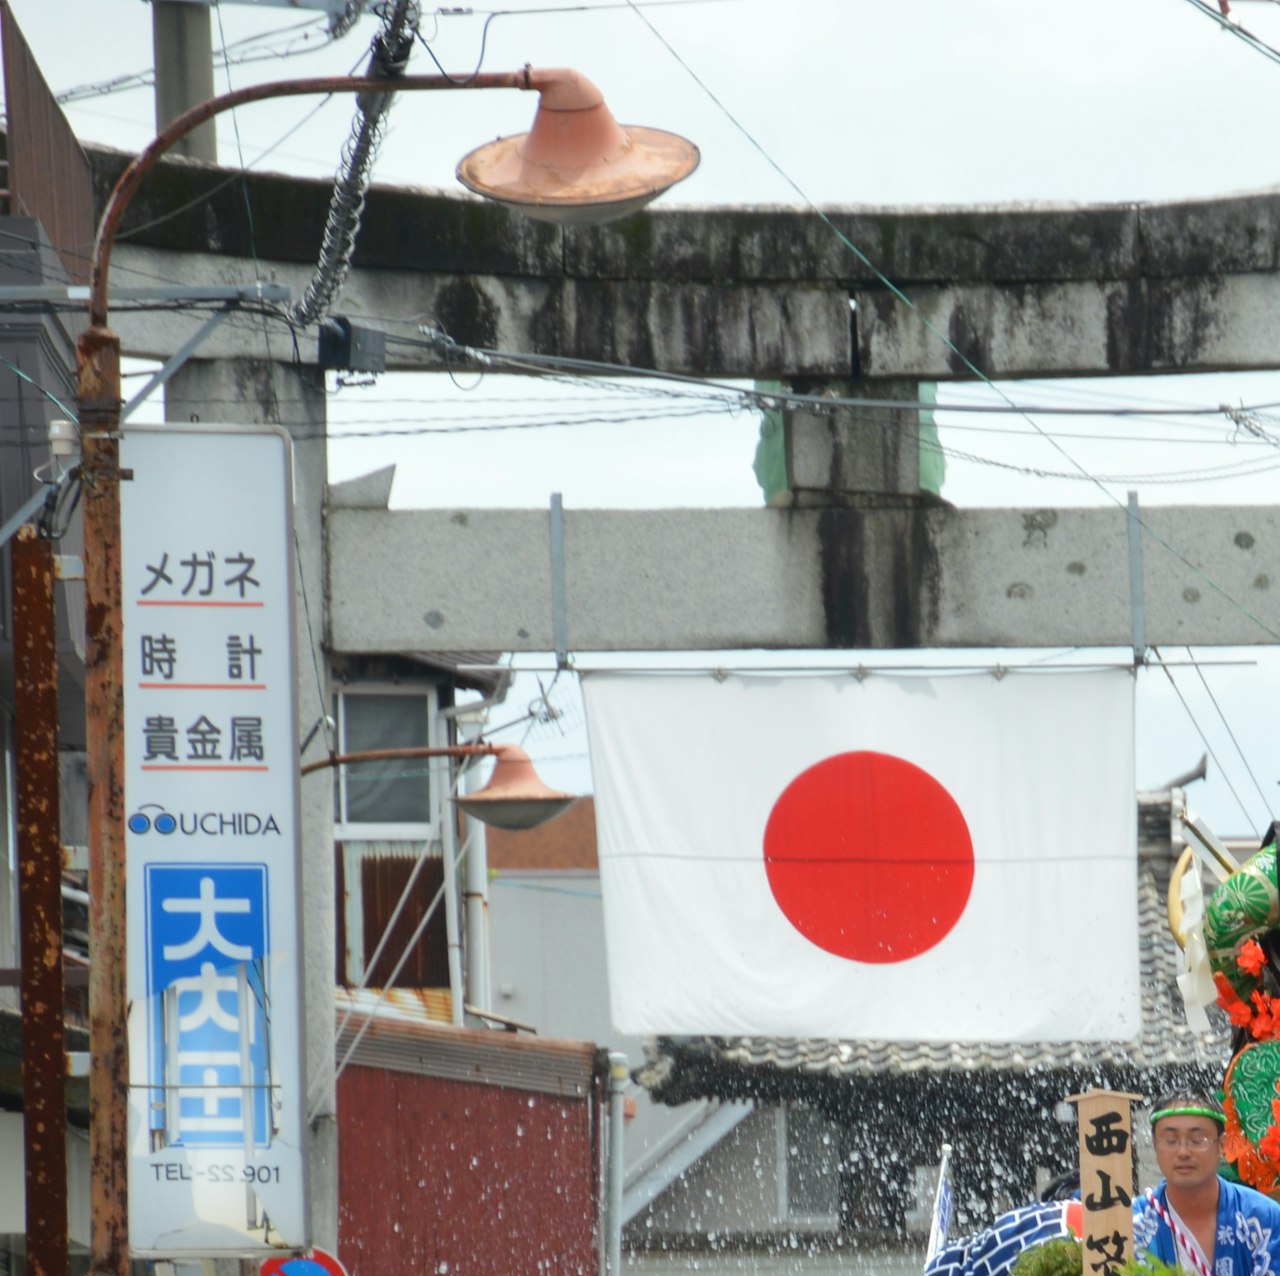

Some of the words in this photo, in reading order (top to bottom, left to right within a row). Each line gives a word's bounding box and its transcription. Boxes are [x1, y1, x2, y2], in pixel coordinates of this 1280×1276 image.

[140, 551, 261, 598] メガネ
[140, 633, 263, 681] 時計
[142, 717, 265, 764] 貴金属
